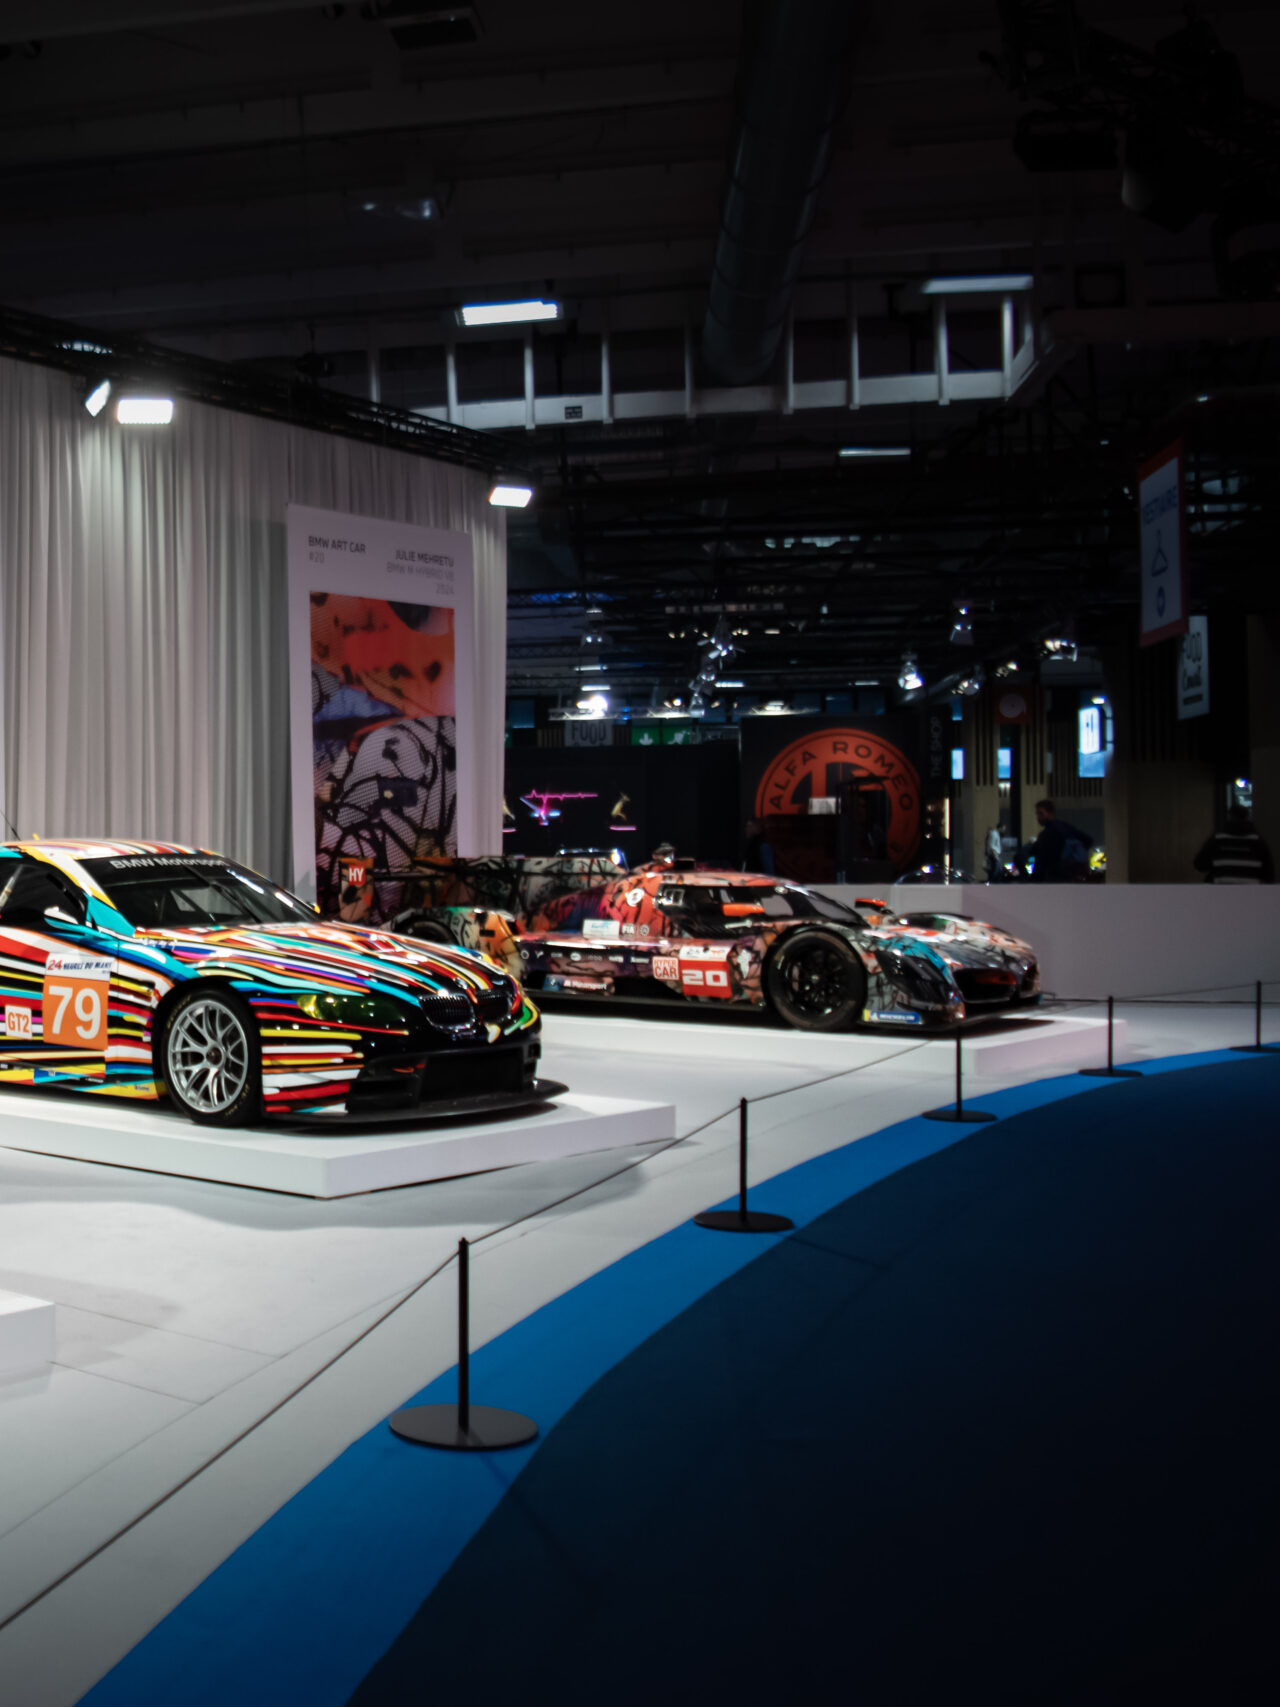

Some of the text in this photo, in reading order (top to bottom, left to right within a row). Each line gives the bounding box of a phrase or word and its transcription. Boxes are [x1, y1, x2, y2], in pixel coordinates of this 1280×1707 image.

[308, 535, 366, 554] BMW ART CAR
[395, 550, 454, 567] JULIE MEHRETU
[770, 741, 913, 811] ALFA ROMEO
[109, 858, 154, 869] BMW
[349, 867, 364, 882] HY
[48, 960, 62, 970] 24
[654, 967, 676, 977] CAR
[682, 970, 728, 987] 20
[49, 985, 101, 1039] 79
[8, 1012, 29, 1032] GT2
